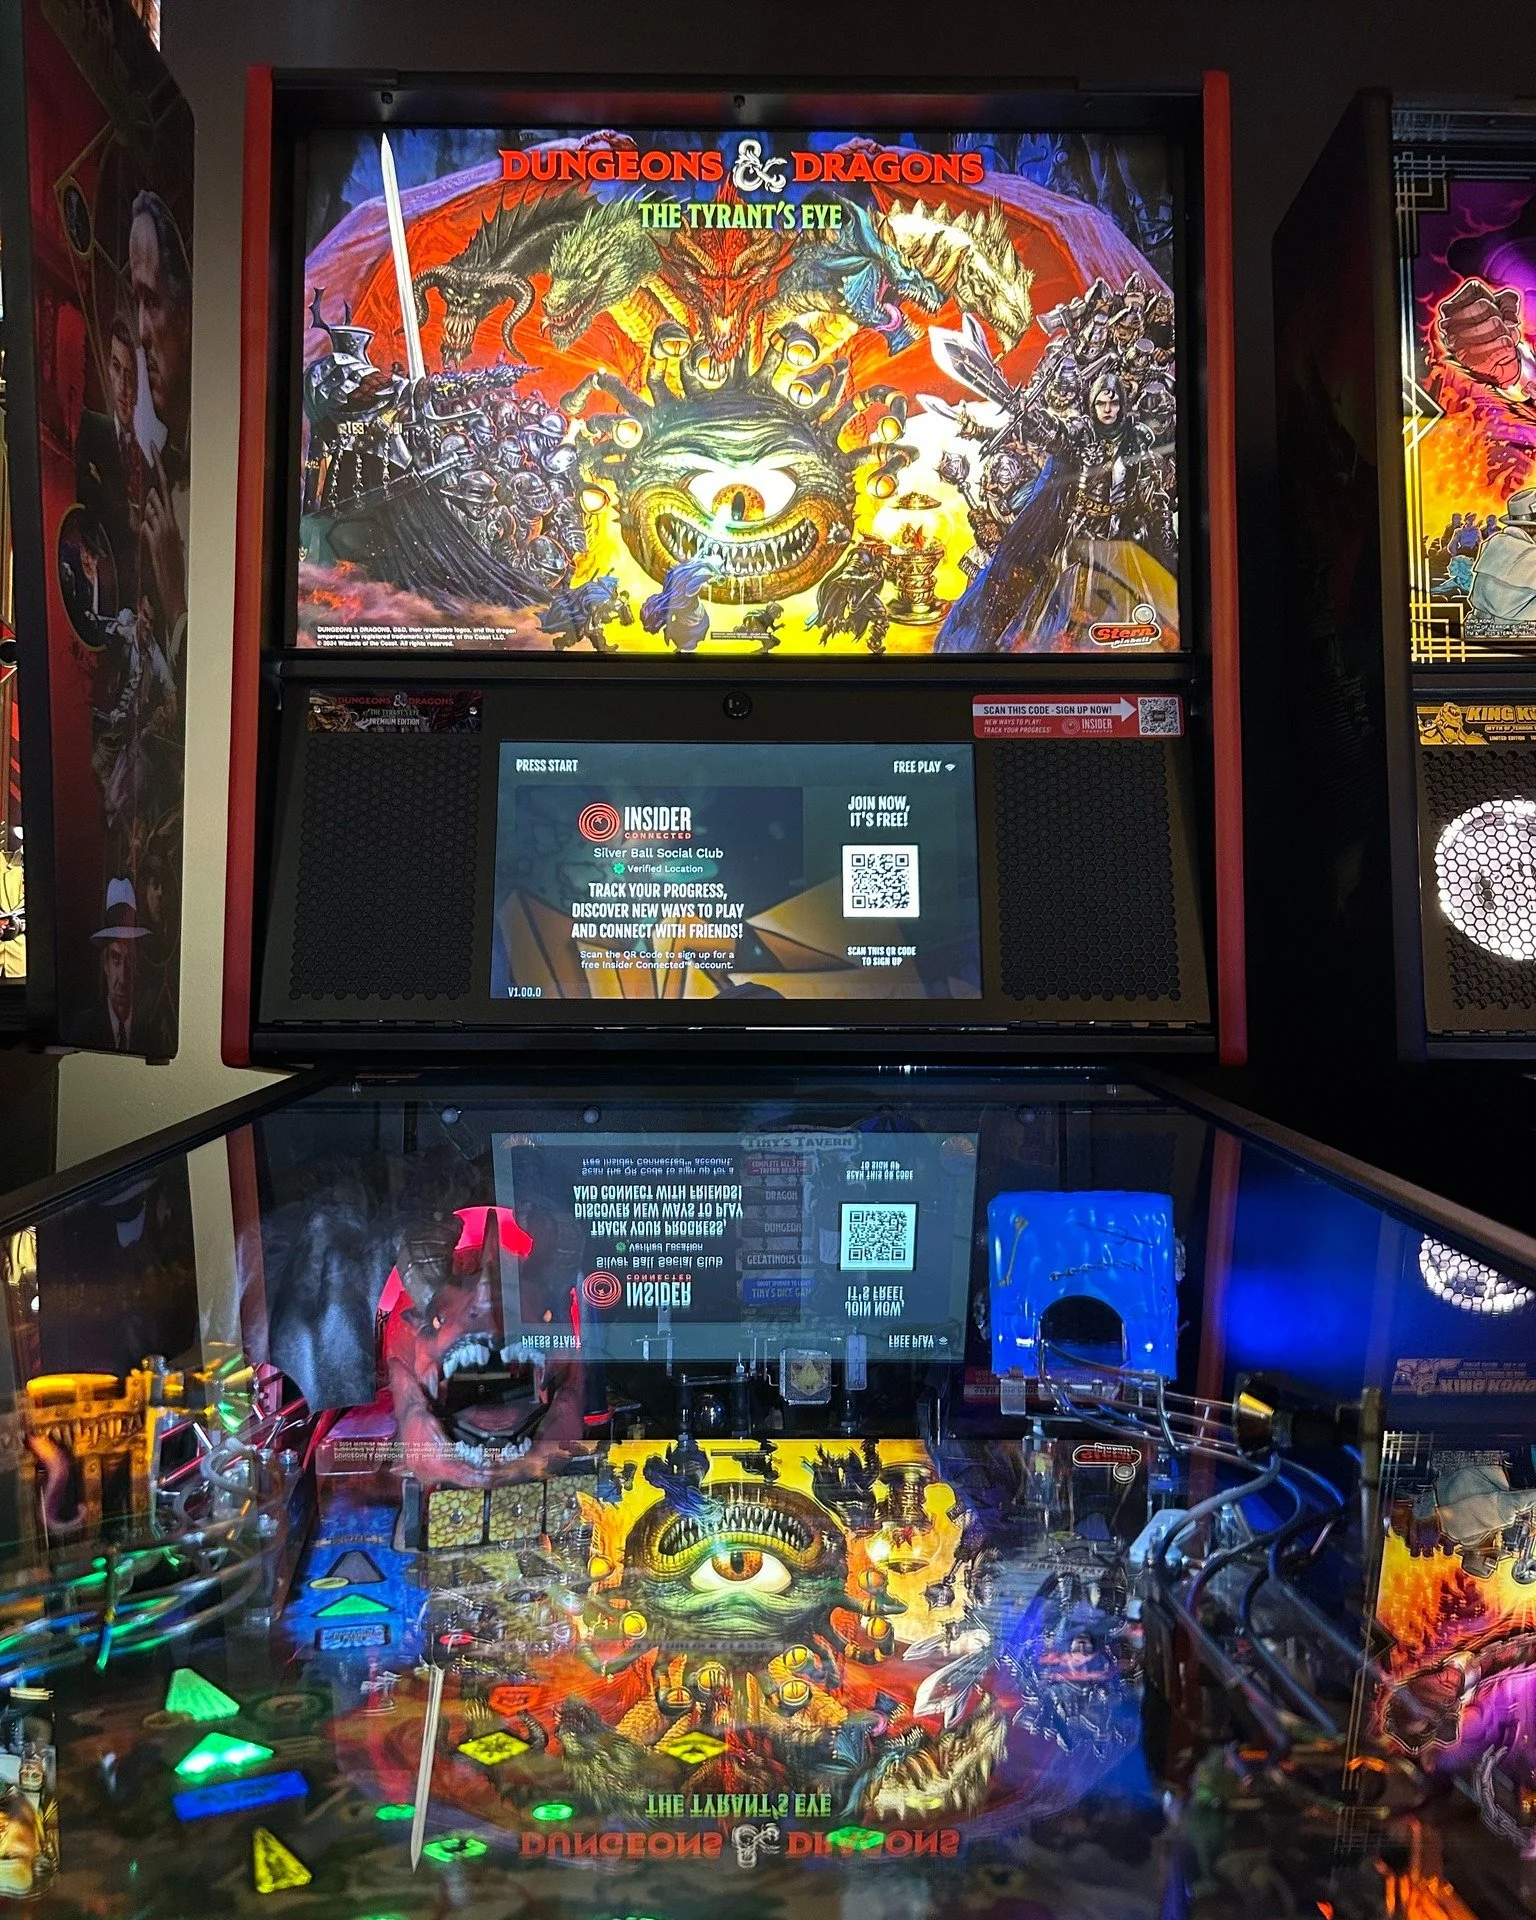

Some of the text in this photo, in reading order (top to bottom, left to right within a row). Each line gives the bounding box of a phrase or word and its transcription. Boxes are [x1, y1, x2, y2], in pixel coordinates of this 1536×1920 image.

[499, 139, 984, 193] DUNGEONS & DRAGONS
[639, 201, 842, 229] THE TYRANT'S EYE
[423, 626, 453, 634] respective
[454, 626, 472, 634] logos,
[1098, 626, 1152, 639] Stern
[1114, 637, 1149, 646] pinball
[336, 697, 391, 705] DUNGEONS
[394, 693, 406, 707] &
[984, 706, 1112, 714] SCAN THIS CODE SIGN UP NOW!
[1468, 707, 1514, 720] KING
[1082, 718, 1112, 729] INSIDER
[516, 759, 578, 772] PRESS START
[894, 761, 942, 773] FREE PLAY
[848, 796, 910, 812] JOIN NOW,
[624, 806, 691, 831] INSIDER
[850, 812, 908, 827] IT'S FREE!
[624, 832, 691, 840] CONNECTED
[594, 848, 724, 858] Silver Ball Social Club
[628, 864, 703, 873] Verified Location
[588, 883, 727, 900] TRACK YOUR PROGRESS,
[572, 903, 744, 918] DISCOVER NEW WAYS TO PLAY
[571, 924, 743, 938] AND CONNECT WITH FRIENDS!
[580, 951, 602, 959] Scan
[606, 951, 620, 959] the
[624, 951, 636, 960] QR
[640, 951, 662, 959] Code
[678, 951, 696, 961] sign
[699, 953, 710, 961] up
[713, 951, 726, 959] for
[847, 946, 916, 956] SCAN THIS QR CODE
[581, 961, 599, 969] free
[602, 961, 633, 969] Insider
[862, 957, 903, 966] TO SIGN UP
[508, 987, 541, 997] V1.00.0
[766, 1191, 798, 1200] DRAGON
[764, 1223, 801, 1232] DUNGEON
[747, 1255, 796, 1264] GELATINOUS
